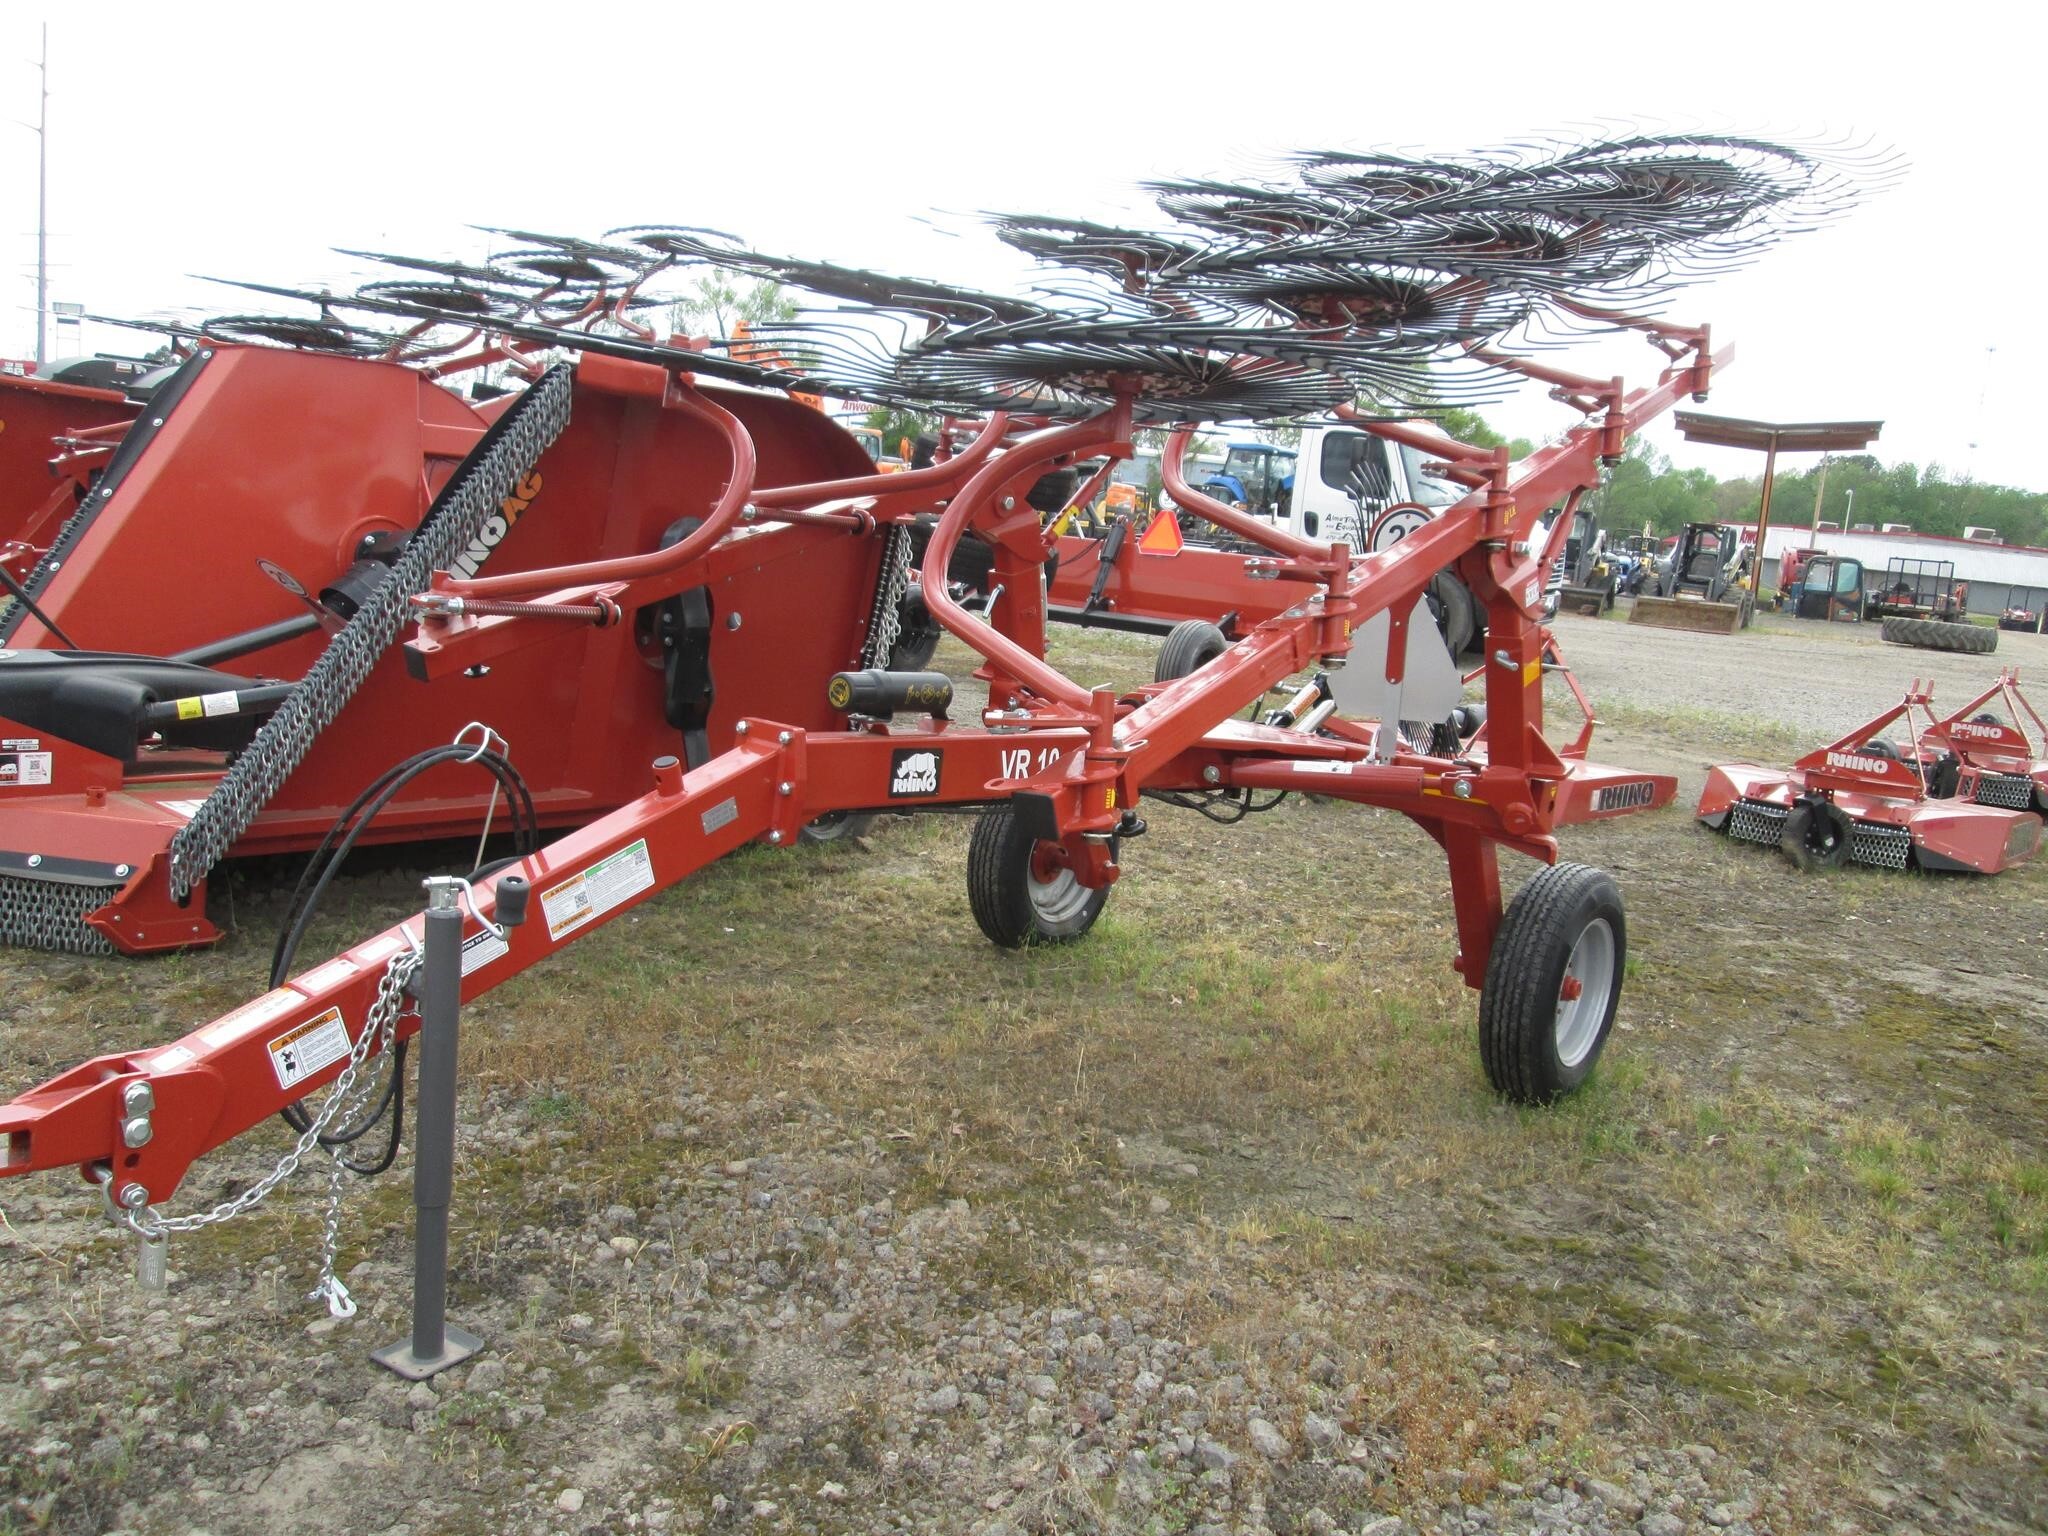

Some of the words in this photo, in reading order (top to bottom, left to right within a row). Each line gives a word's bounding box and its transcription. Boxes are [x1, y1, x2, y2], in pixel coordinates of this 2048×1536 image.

[1389, 524, 1421, 546] 2
[1950, 722, 2003, 739] RHINO
[1001, 748, 1031, 779] VR
[1826, 751, 1888, 774] RHINO
[893, 777, 937, 793] RHINO
[1598, 781, 1655, 812] RHINO
[288, 1015, 329, 1041] WARNING
